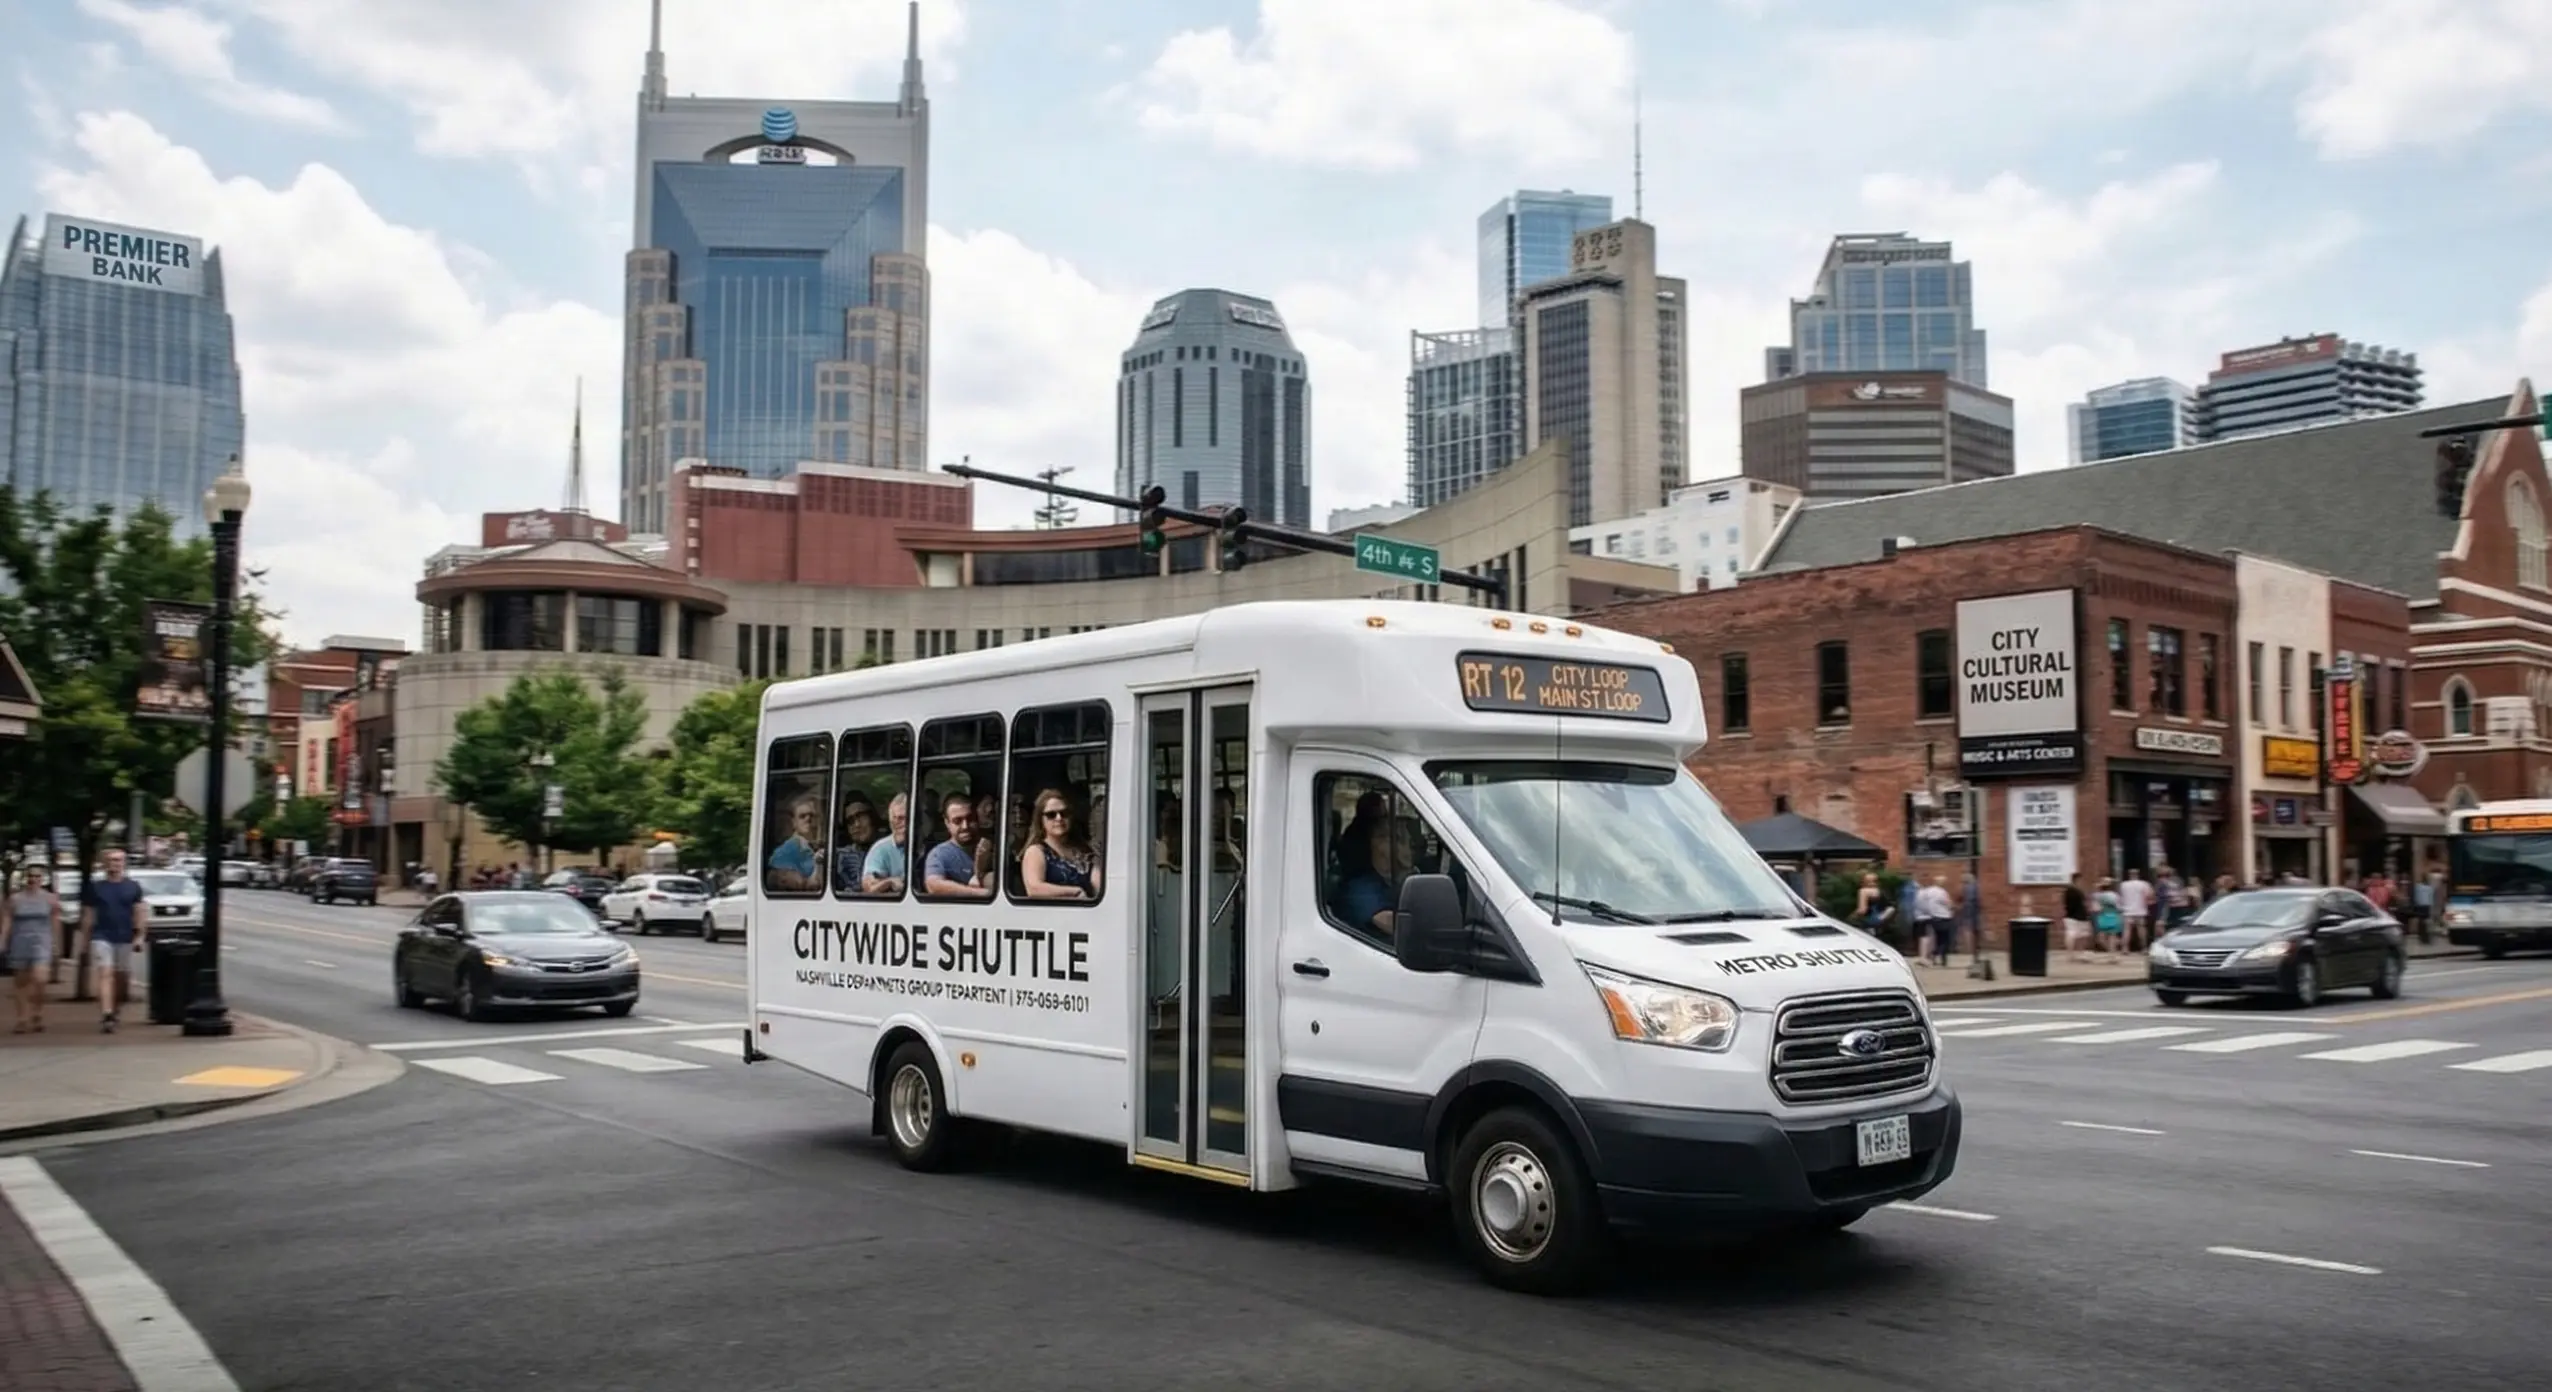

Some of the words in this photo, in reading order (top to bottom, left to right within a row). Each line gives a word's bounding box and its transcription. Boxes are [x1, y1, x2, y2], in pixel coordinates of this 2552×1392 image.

[63, 225, 190, 269] PREMIER
[93, 256, 163, 286] BANK
[1361, 544, 1392, 566] 4th
[1421, 556, 1434, 576] S
[1991, 627, 2040, 651] CITY
[1552, 665, 1587, 686] CITY
[1591, 668, 1629, 690] LOOP
[1963, 651, 2072, 679] CULTURAL
[1463, 662, 1494, 699] RT
[1500, 665, 1527, 701] 12
[1970, 677, 2064, 705] MUSEUM
[1538, 686, 1577, 708] MAIN
[1579, 689, 1600, 710] ST
[1605, 691, 1642, 712] LOOP
[794, 918, 929, 969] CITYWIDE
[937, 925, 1090, 982] SHUTTLE
[1714, 953, 1798, 976] METRO
[1795, 949, 1891, 967] SHUTTLE
[908, 978, 943, 997] GROUP
